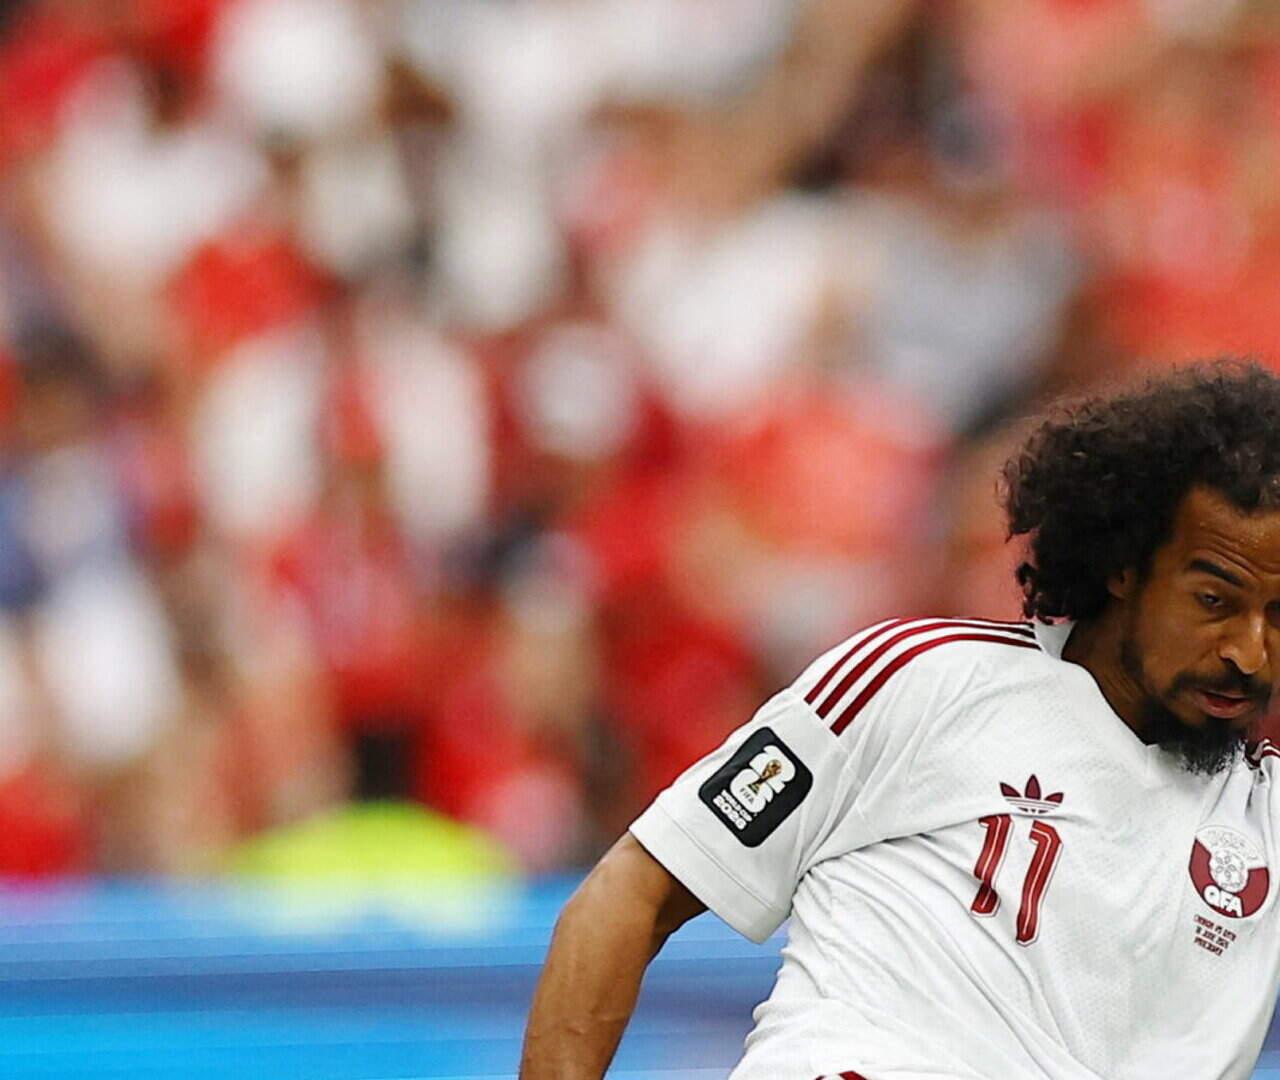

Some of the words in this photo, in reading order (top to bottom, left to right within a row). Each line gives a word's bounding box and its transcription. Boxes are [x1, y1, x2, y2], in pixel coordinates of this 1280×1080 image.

[712, 794, 748, 831] 2026
[970, 813, 1064, 947] 11
[1202, 884, 1244, 918] QFA
